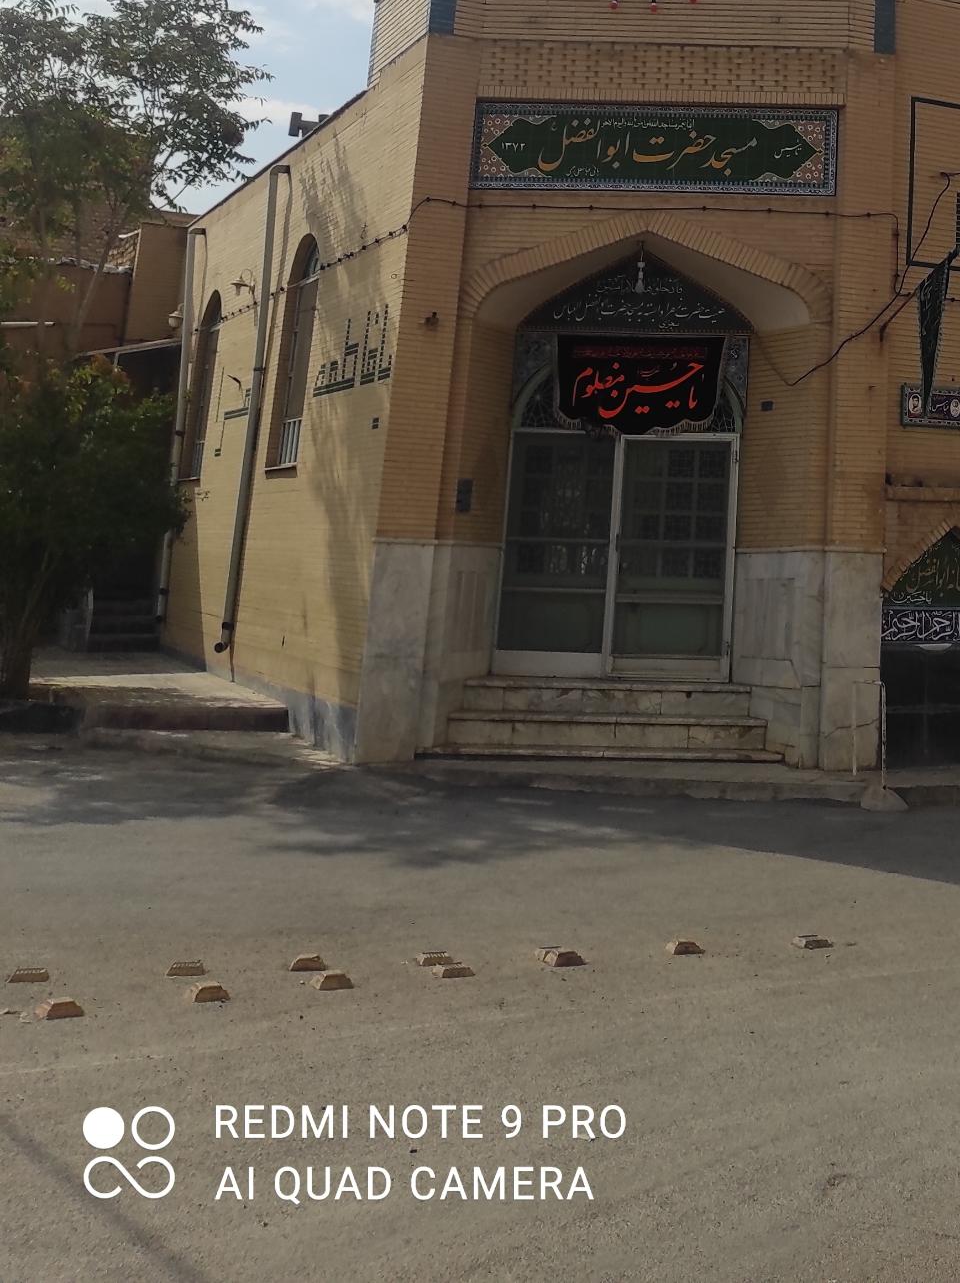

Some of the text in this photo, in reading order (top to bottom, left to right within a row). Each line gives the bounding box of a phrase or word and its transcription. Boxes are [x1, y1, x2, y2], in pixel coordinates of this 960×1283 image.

[631, 129, 718, 171] حضرت
[698, 136, 758, 177] مسجد
[571, 360, 706, 419] یا حسین مظلوم
